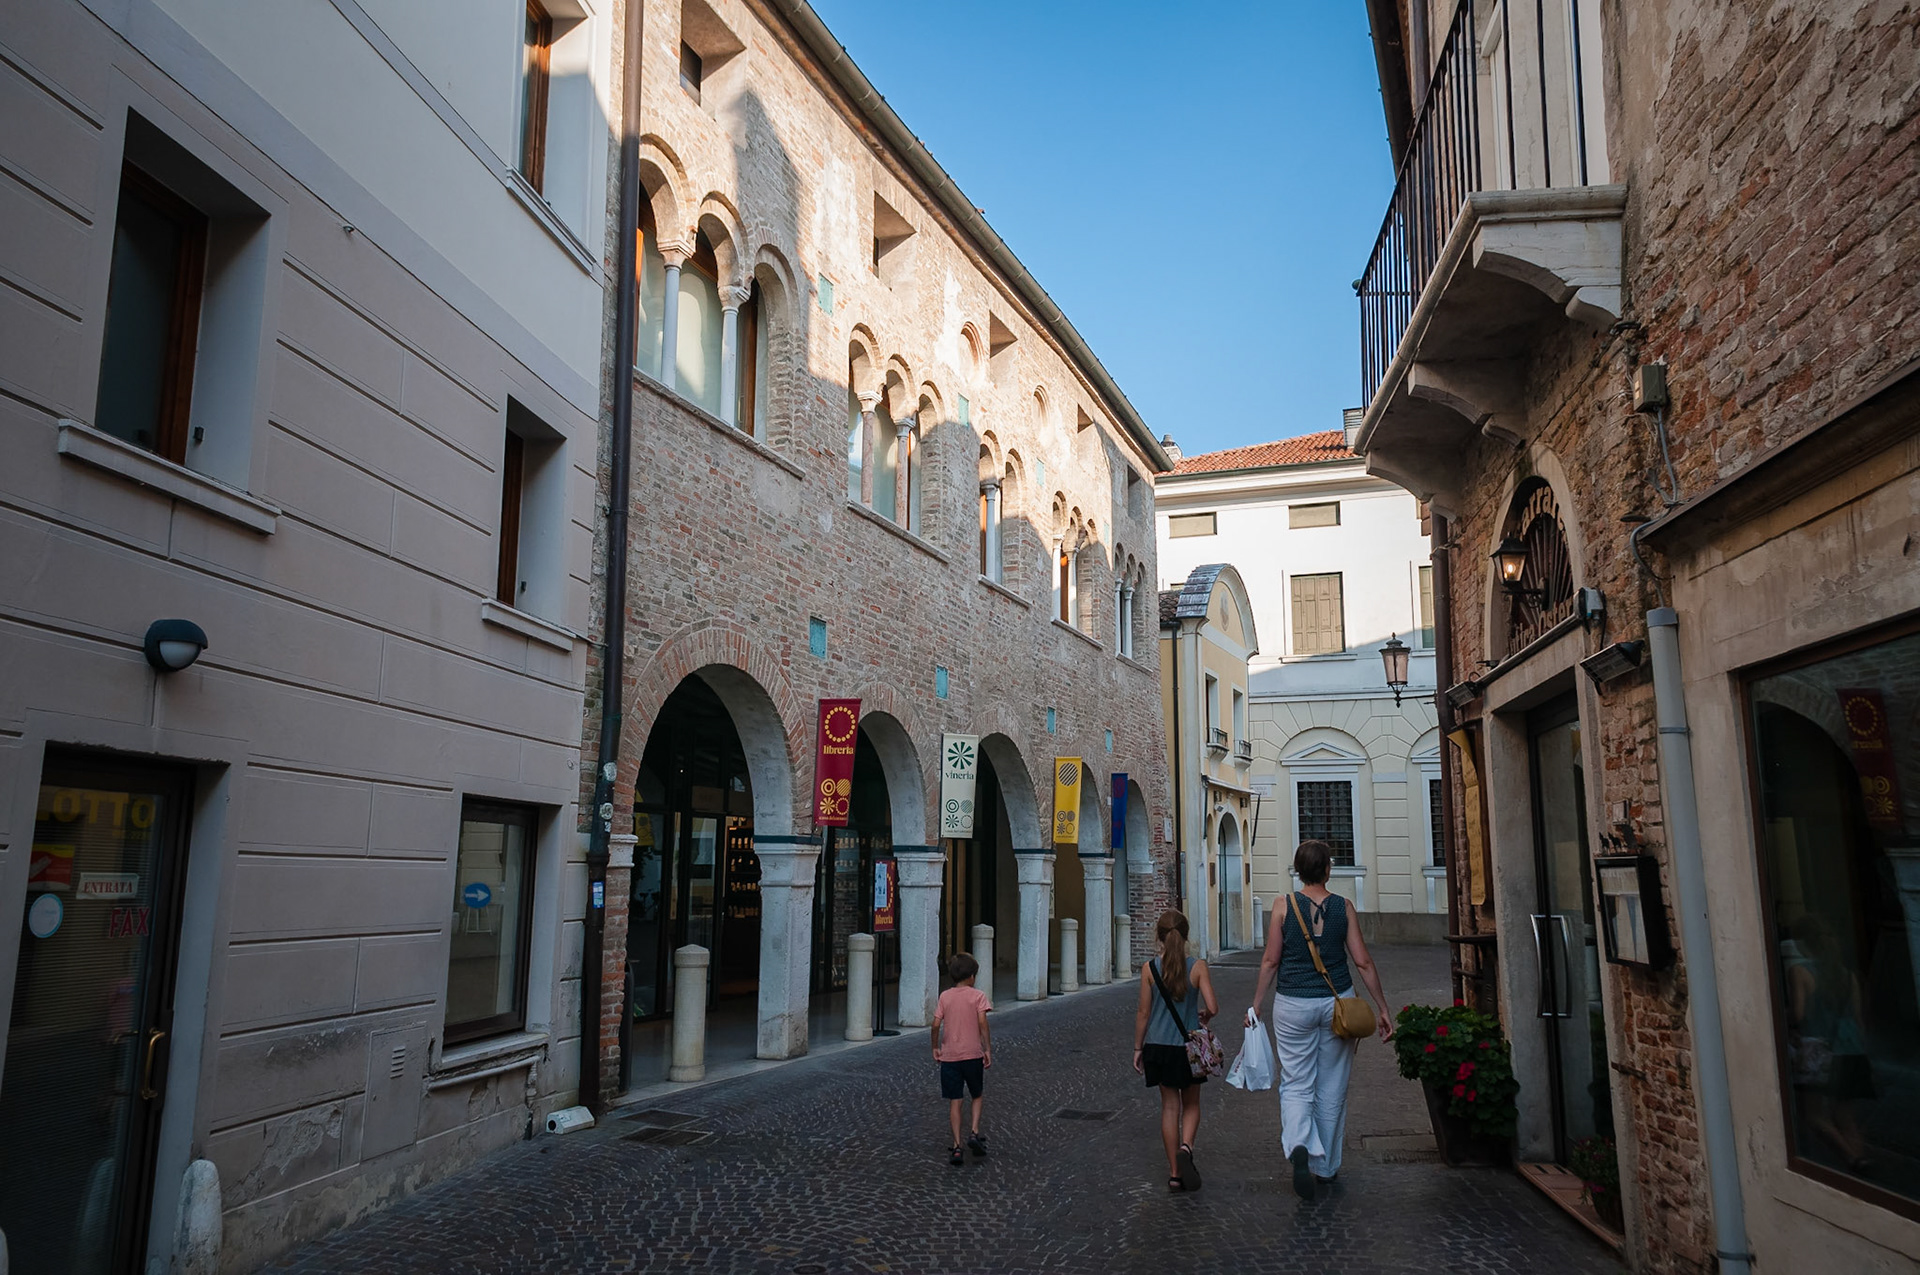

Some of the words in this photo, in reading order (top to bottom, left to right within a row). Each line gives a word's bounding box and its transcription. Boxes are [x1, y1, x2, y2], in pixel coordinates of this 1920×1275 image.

[1538, 596, 1574, 636] Oster
[823, 744, 854, 755] libreria
[945, 770, 974, 780] vineria
[84, 881, 133, 894] ENTRATA
[109, 907, 151, 938] FAX
